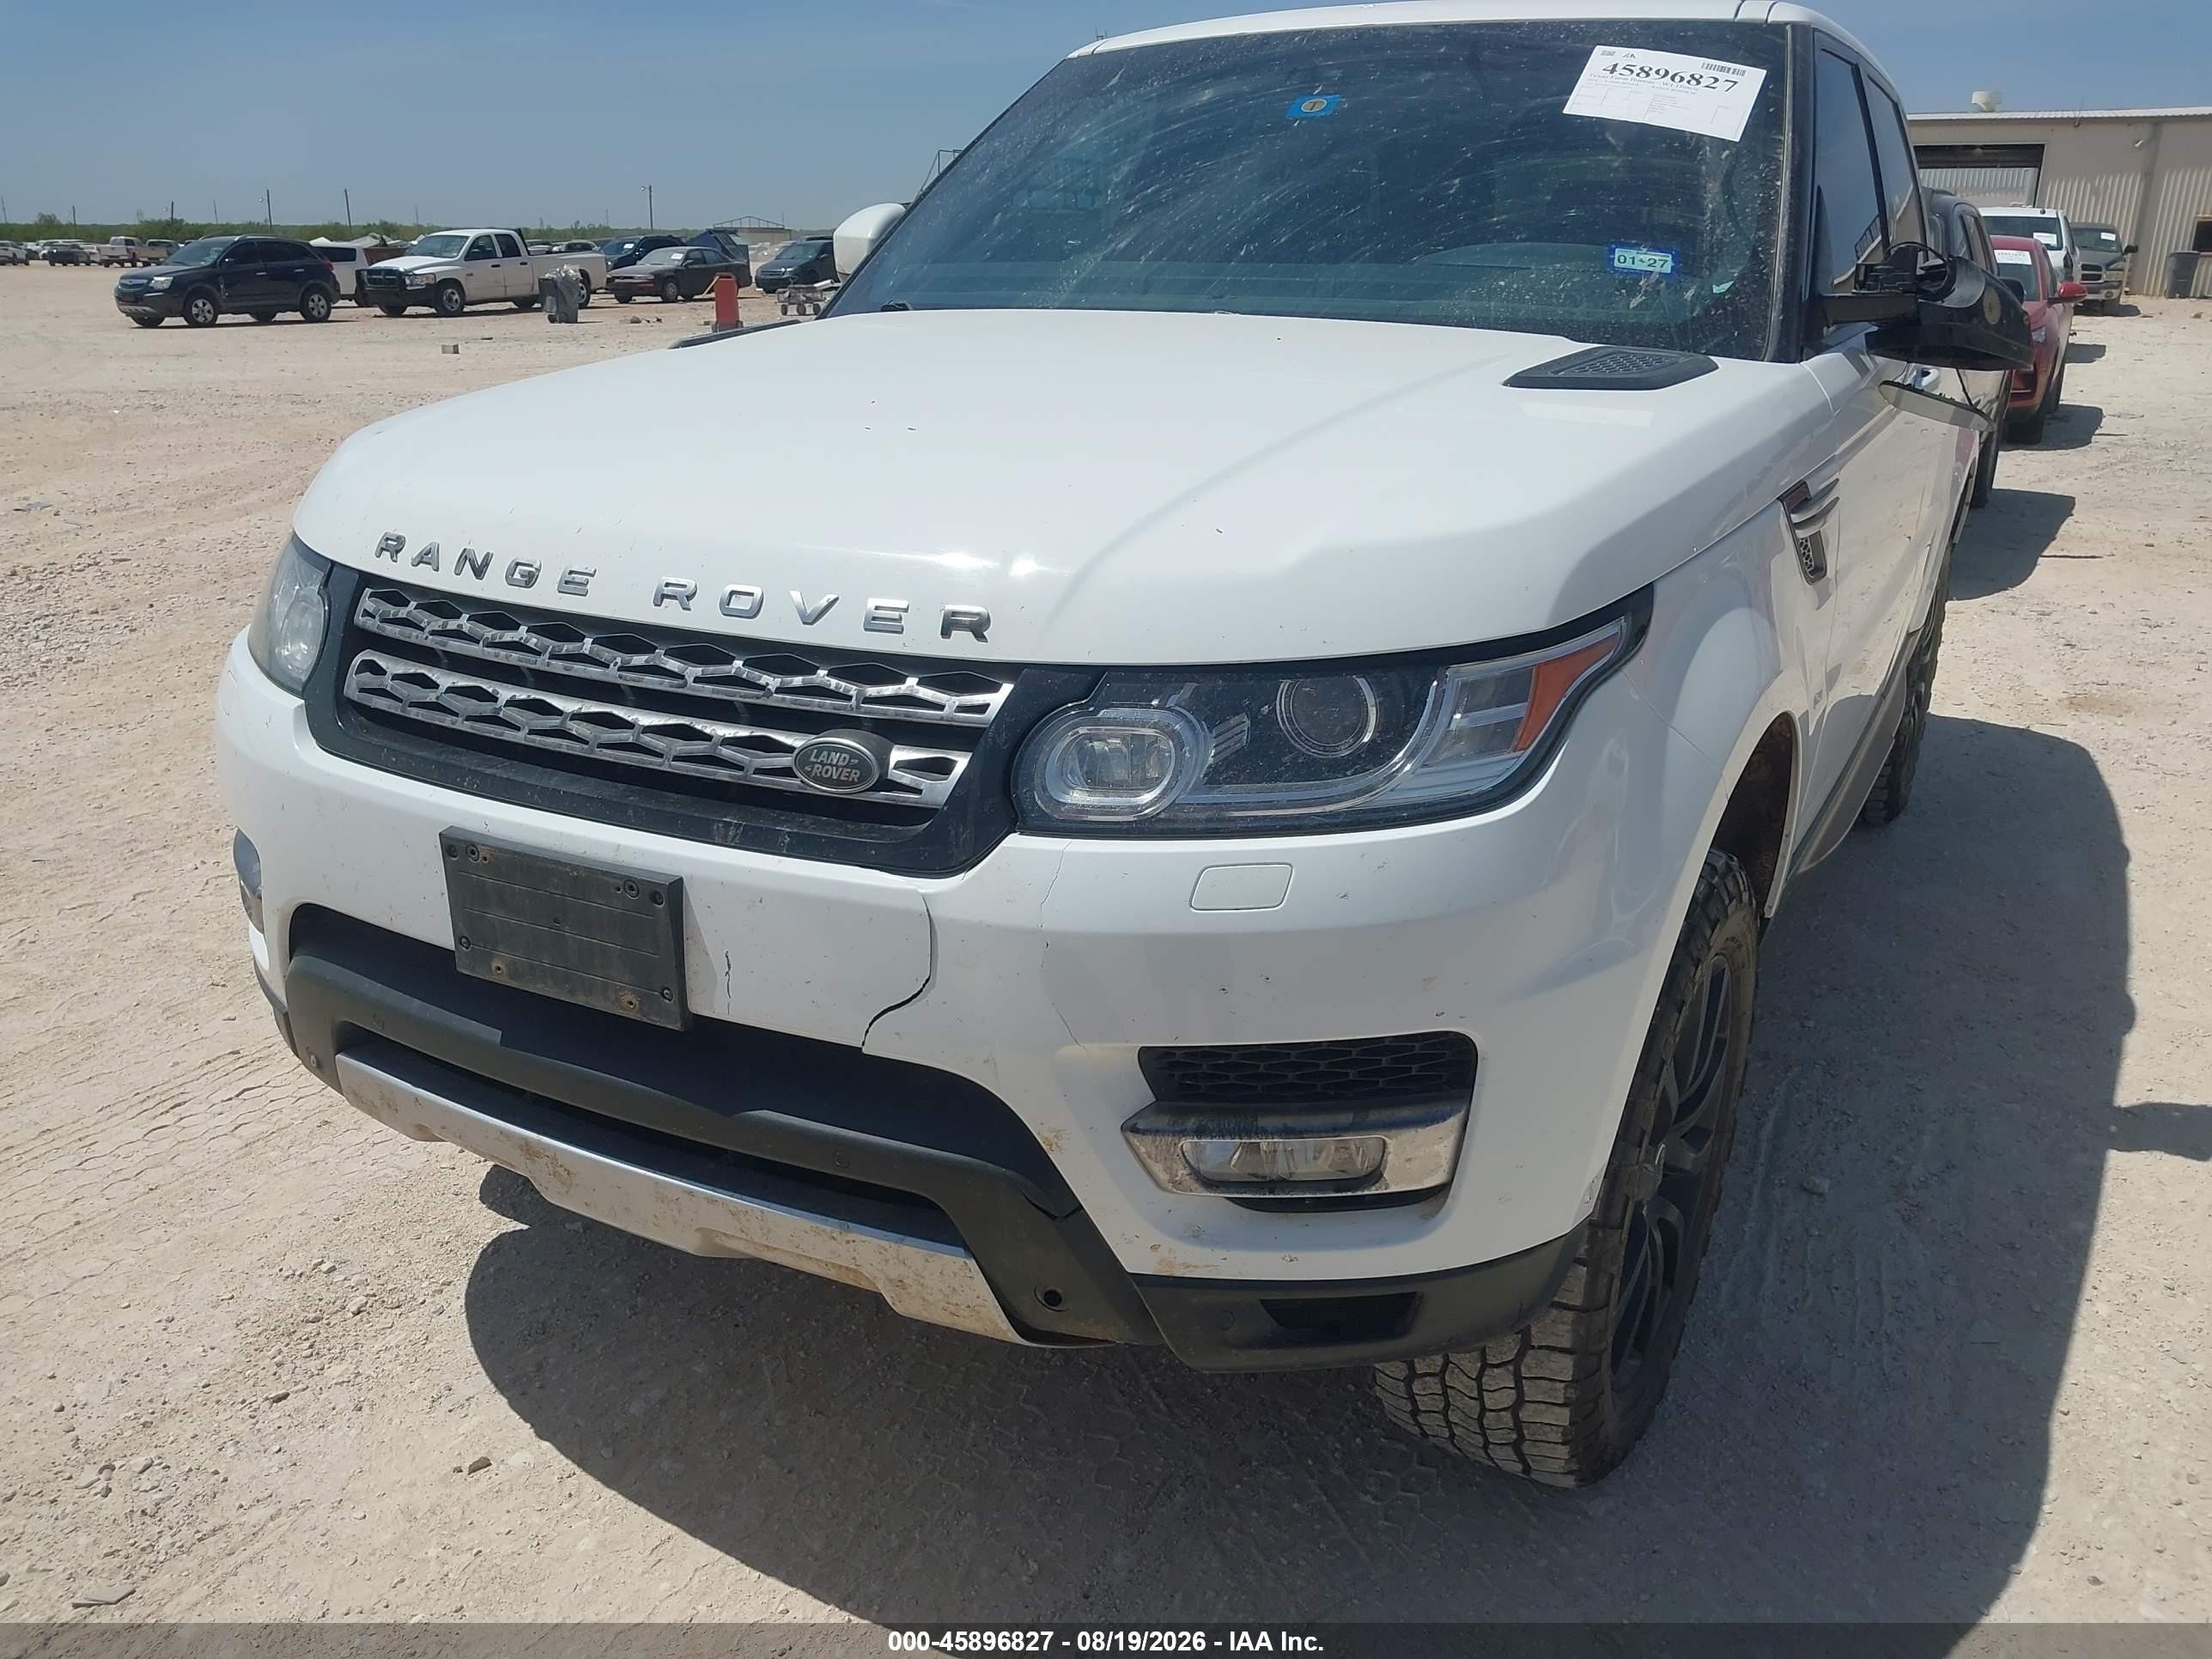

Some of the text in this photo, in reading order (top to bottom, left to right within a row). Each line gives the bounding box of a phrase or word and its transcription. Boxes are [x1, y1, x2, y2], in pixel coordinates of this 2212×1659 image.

[1602, 62, 1739, 93] 45896827
[374, 531, 994, 643] RANGE ROVER
[810, 750, 850, 766] LAND
[811, 763, 860, 782] ROVER
